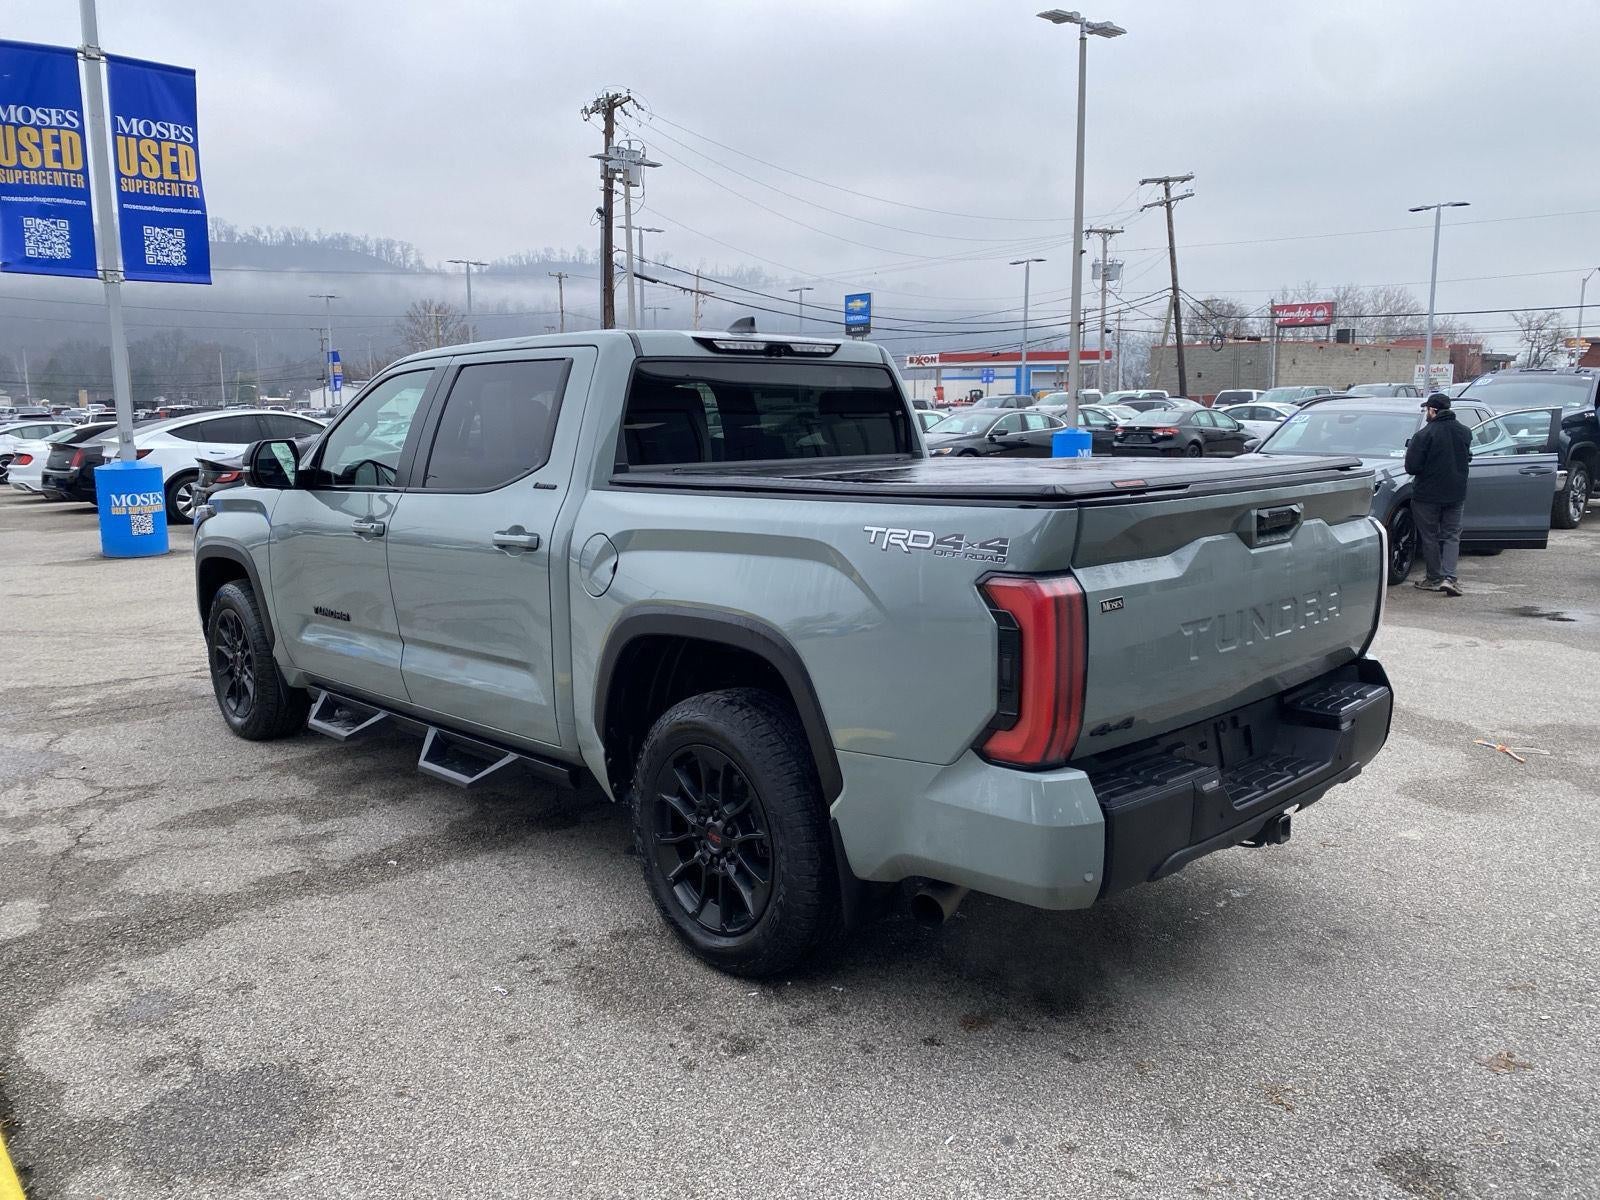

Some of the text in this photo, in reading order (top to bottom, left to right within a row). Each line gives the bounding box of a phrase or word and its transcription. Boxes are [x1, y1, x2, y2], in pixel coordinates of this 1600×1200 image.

[0, 105, 80, 128] MOSES
[115, 115, 194, 143] MOSES
[0, 125, 84, 171] USED
[116, 136, 197, 182] USED
[0, 169, 85, 189] SUPERCENTER
[120, 177, 200, 198] SUPERCENTER
[1, 195, 86, 206] mosesusedsupercenter.com
[123, 203, 202, 214] mosesusedsupercenter.com
[1275, 306, 1312, 323] Wendy's
[908, 355, 937, 366] EXXON
[1418, 366, 1449, 374] Dight's
[110, 492, 163, 507] MOSES
[864, 525, 936, 554] TRD
[933, 550, 1008, 565] OFF ROAD
[313, 605, 352, 621] TUNDRA
[1180, 584, 1343, 662] TUNDRA
